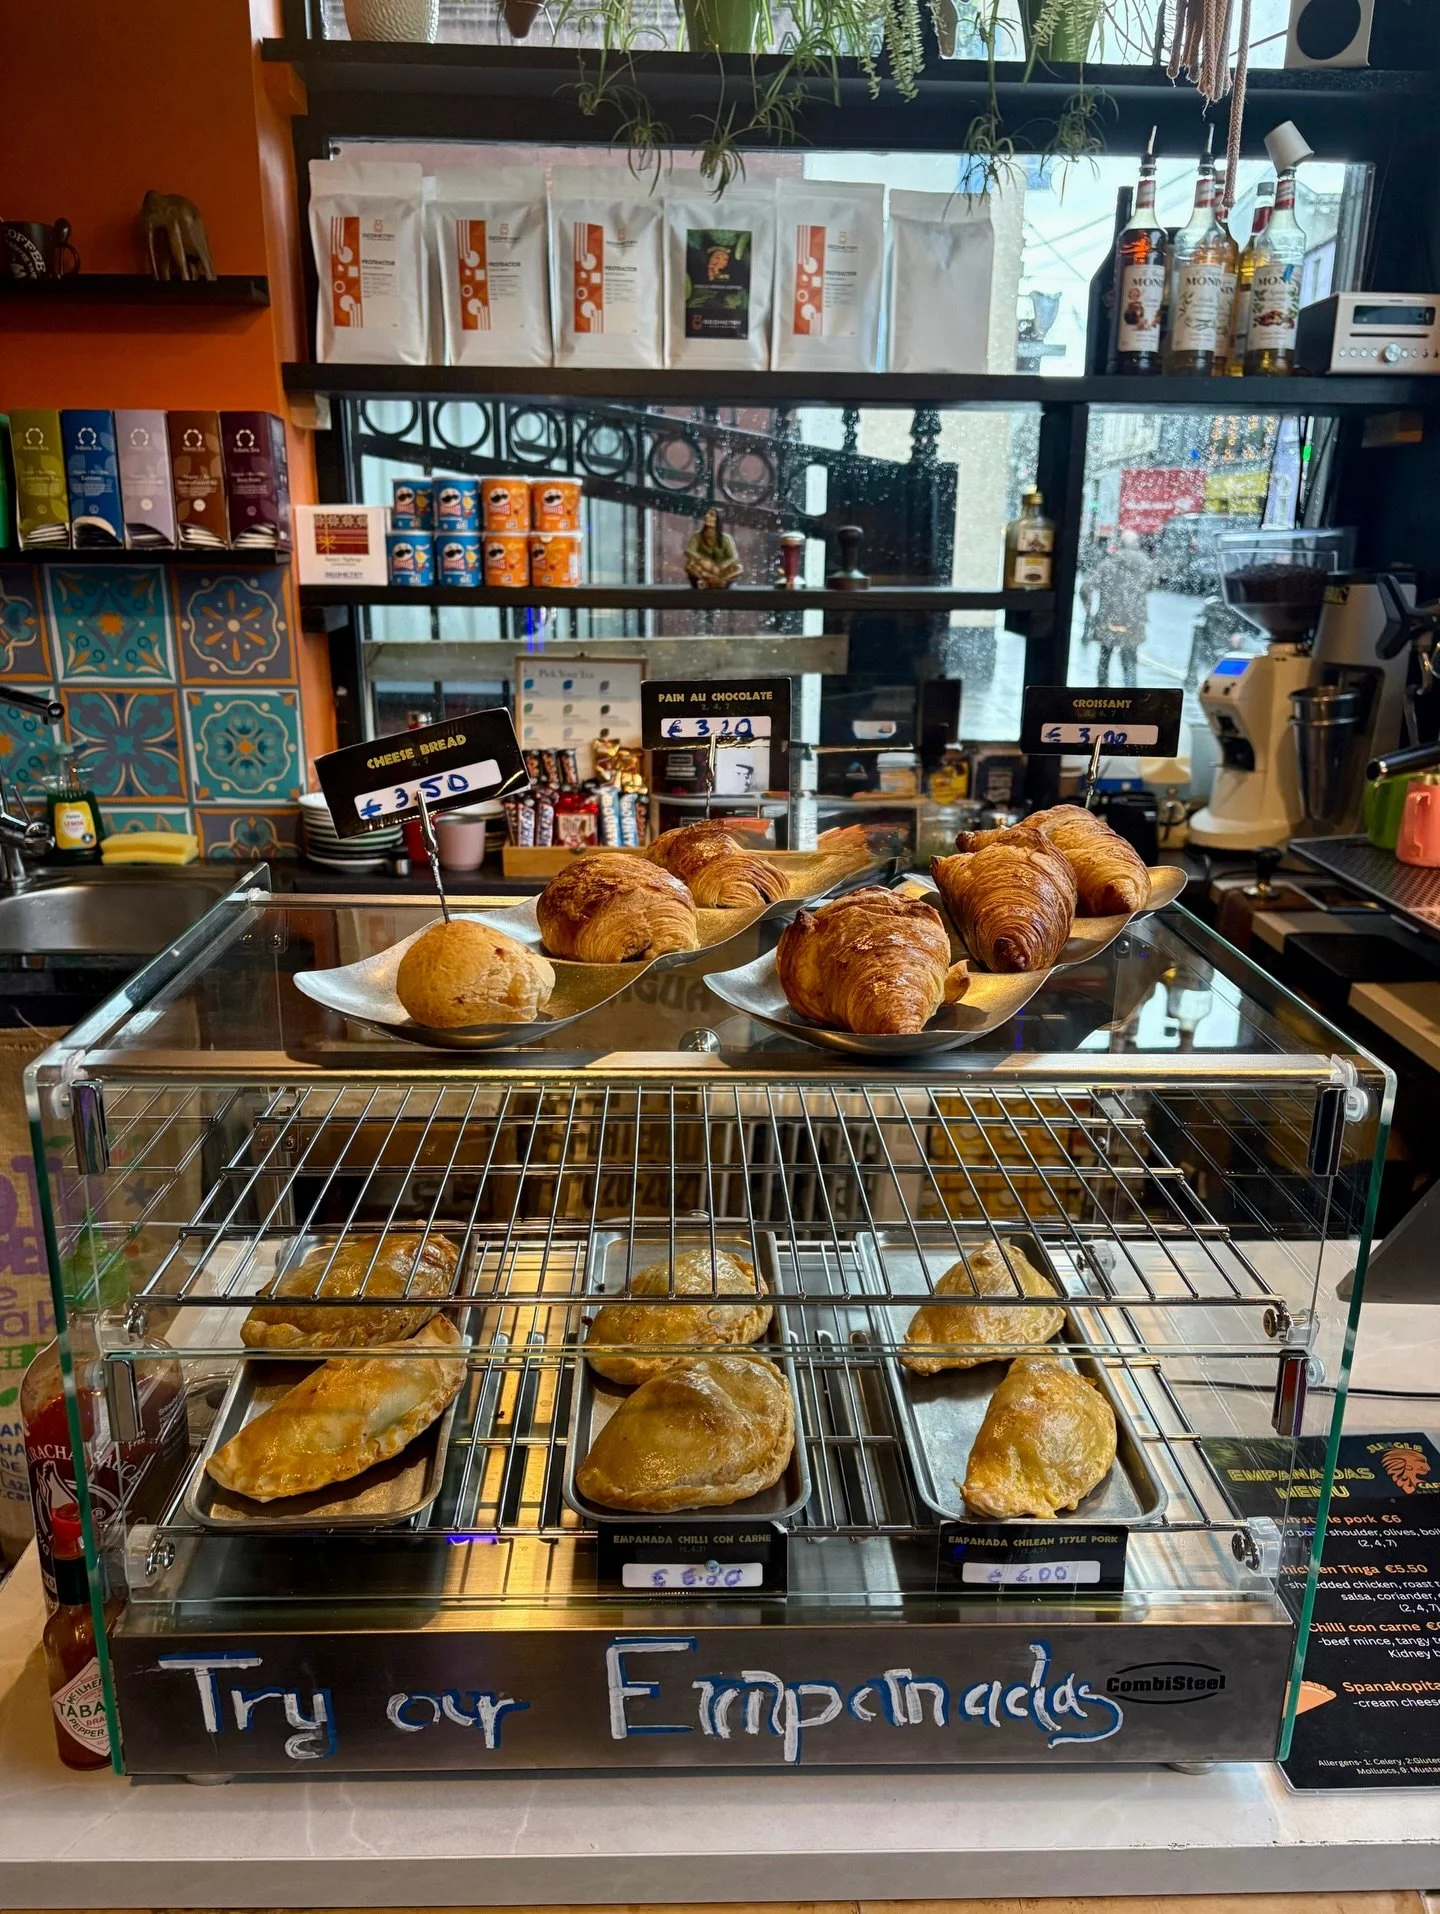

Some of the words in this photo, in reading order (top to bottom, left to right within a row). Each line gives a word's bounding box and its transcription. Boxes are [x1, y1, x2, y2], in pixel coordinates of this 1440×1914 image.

[4, 228, 47, 273] OFFEE
[658, 693, 685, 703] PAIN
[690, 693, 707, 702] AU
[711, 691, 773, 701] CHOCOLATE
[1072, 699, 1133, 709] CROISSANT
[366, 747, 415, 770] CHEESE
[419, 734, 467, 756] BREAD
[1227, 1467, 1376, 1481] EMPANADAS
[1274, 1485, 1351, 1500] MENU
[1345, 1514, 1378, 1526] pork
[1380, 1514, 1403, 1524] €6
[1329, 1527, 1382, 1538] shoulder,
[1382, 1527, 1420, 1538] olives,
[613, 1535, 673, 1545] EMPANADA
[677, 1535, 708, 1545] CHILLI
[712, 1535, 735, 1544] CON
[738, 1534, 772, 1543] CARNE
[948, 1535, 1008, 1547] EMPANADA
[1012, 1536, 1055, 1547] CHILEAN
[1059, 1535, 1087, 1544] STYLE
[1090, 1535, 1119, 1544] PORK
[1337, 1563, 1381, 1576] Tinga
[1384, 1563, 1429, 1574] €5.50
[1353, 1580, 1402, 1590] chicken,
[1403, 1580, 1433, 1589] roast
[1340, 1592, 1377, 1602] salsa,
[1378, 1592, 1438, 1602] coriander,
[1308, 1622, 1346, 1633] Chilli
[1348, 1623, 1377, 1632] con
[1379, 1622, 1422, 1632] carne
[1318, 1636, 1350, 1646] -beef
[1354, 1636, 1396, 1647] mince,
[1395, 1637, 1430, 1647] tangy
[1388, 1649, 1432, 1660] Kidney
[1106, 1674, 1227, 1692] CombiSteel
[158, 1649, 337, 1760] Try
[385, 1686, 531, 1750] our
[1353, 1699, 1399, 1709] -cream
